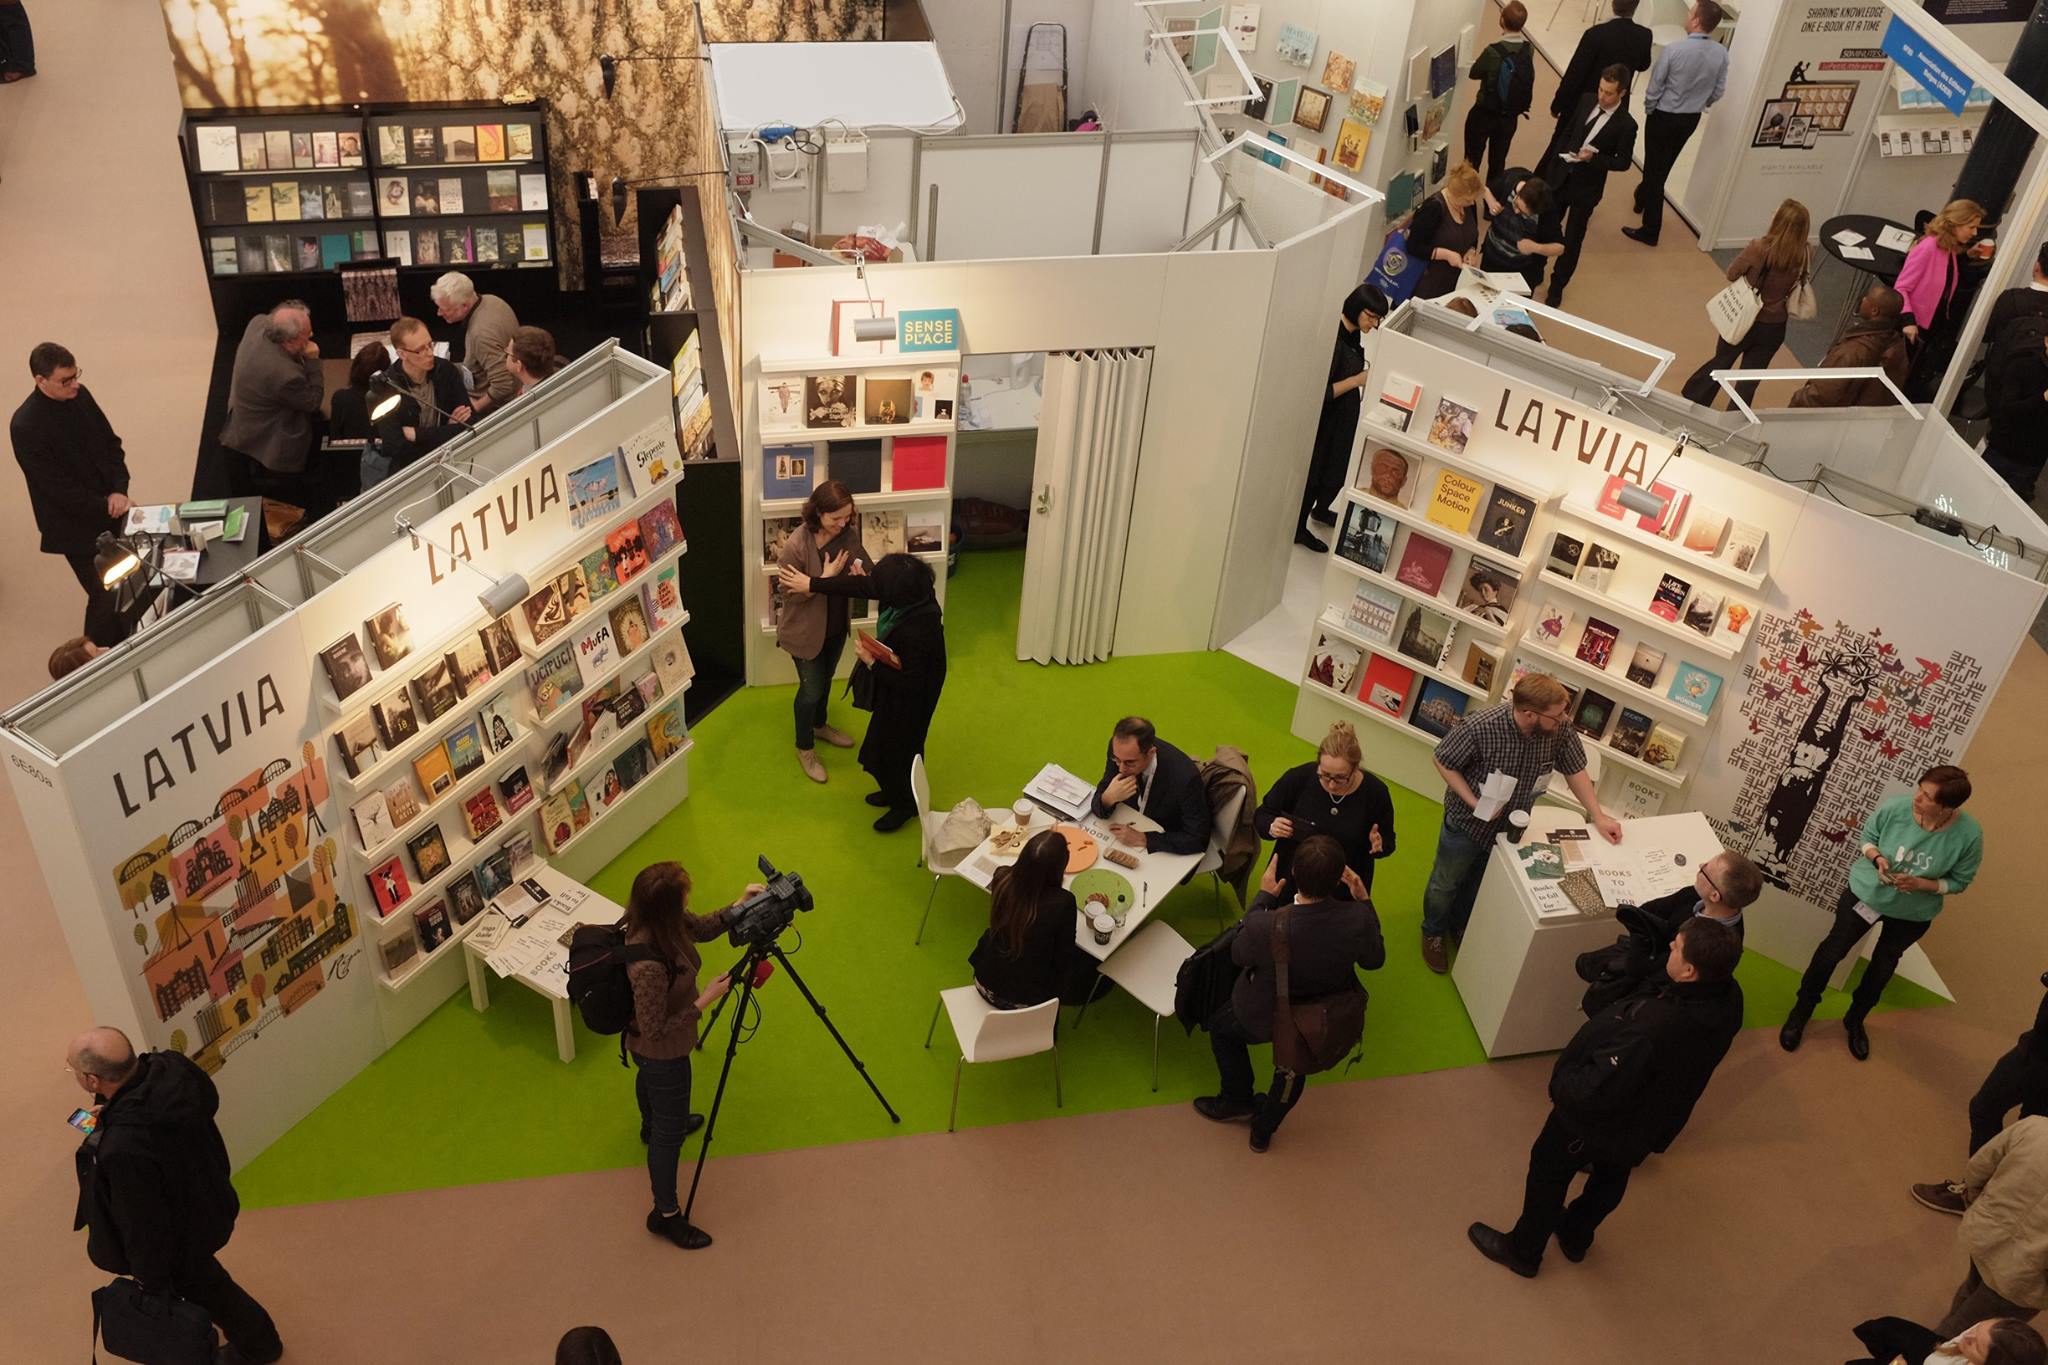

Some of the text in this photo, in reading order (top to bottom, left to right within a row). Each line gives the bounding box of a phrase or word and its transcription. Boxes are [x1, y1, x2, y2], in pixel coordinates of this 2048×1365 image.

[1806, 6, 1885, 19] SHARING KNOWLEDGE
[1801, 20, 1881, 33] ONE E-BOOK AT A TIME
[904, 320, 953, 334] SENSE
[904, 331, 953, 345] PLACE
[1495, 388, 1648, 486] LATVIA
[1443, 474, 1478, 495] Colour
[1440, 483, 1472, 503] Space
[1436, 494, 1471, 515] Motion
[1497, 497, 1527, 516] JUNKER
[427, 463, 561, 586] LATVIA
[399, 720, 408, 731] 18
[112, 673, 286, 819] LATVIA
[1628, 781, 1660, 800] BOOKS
[1634, 794, 1647, 804] TO
[1598, 868, 1633, 878] BOOKS
[1611, 879, 1625, 887] TO
[530, 950, 558, 977] BOOKS
[547, 963, 562, 975] TO
